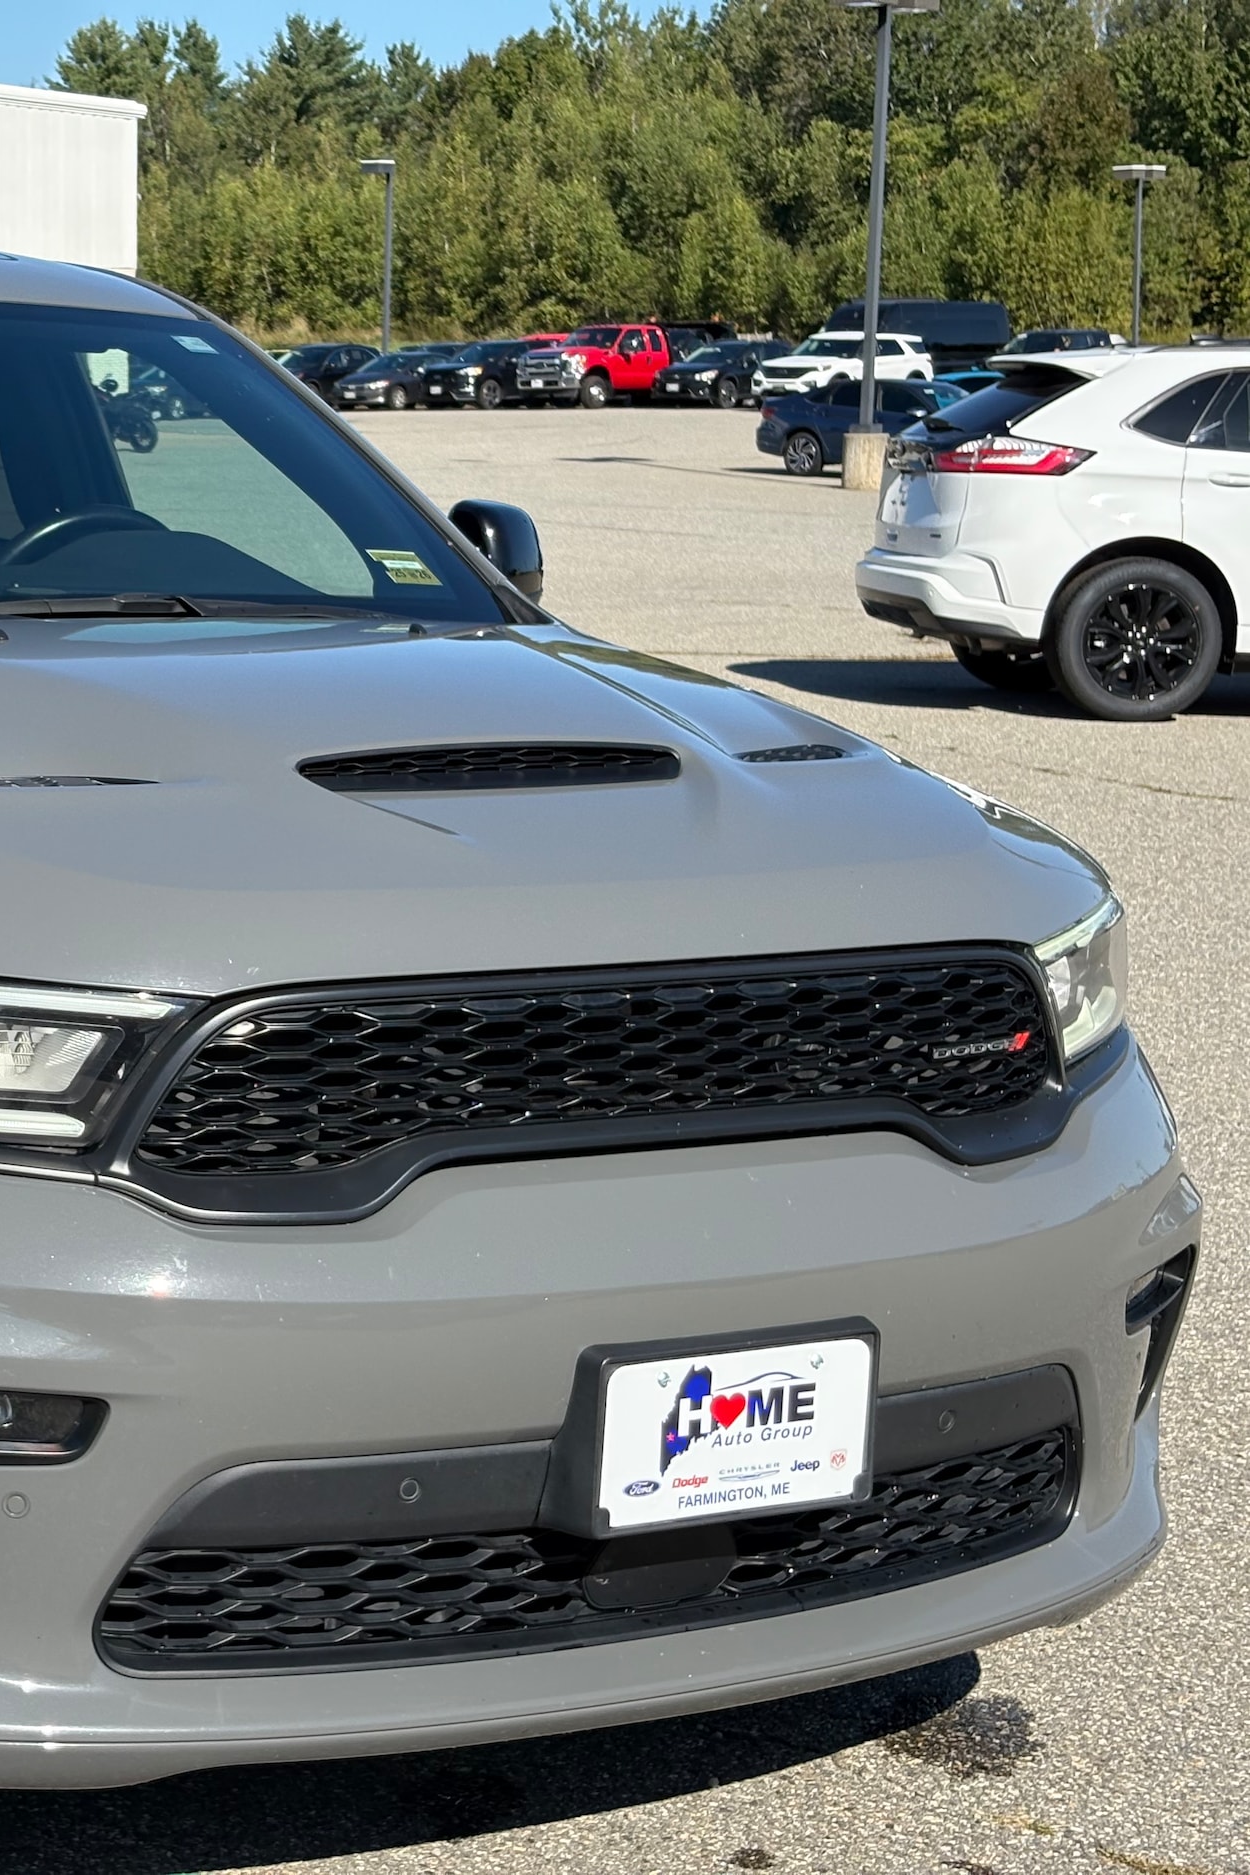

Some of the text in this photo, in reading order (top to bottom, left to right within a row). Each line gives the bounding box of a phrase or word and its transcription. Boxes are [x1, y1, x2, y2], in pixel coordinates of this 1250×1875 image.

[711, 1425, 813, 1448] Auto Group
[718, 1462, 781, 1475] CHRYSLER
[790, 1459, 820, 1472] Jeep
[628, 1481, 654, 1495] Ford
[672, 1475, 709, 1488] Dodge
[678, 1482, 790, 1509] FARMINGTON, ME
